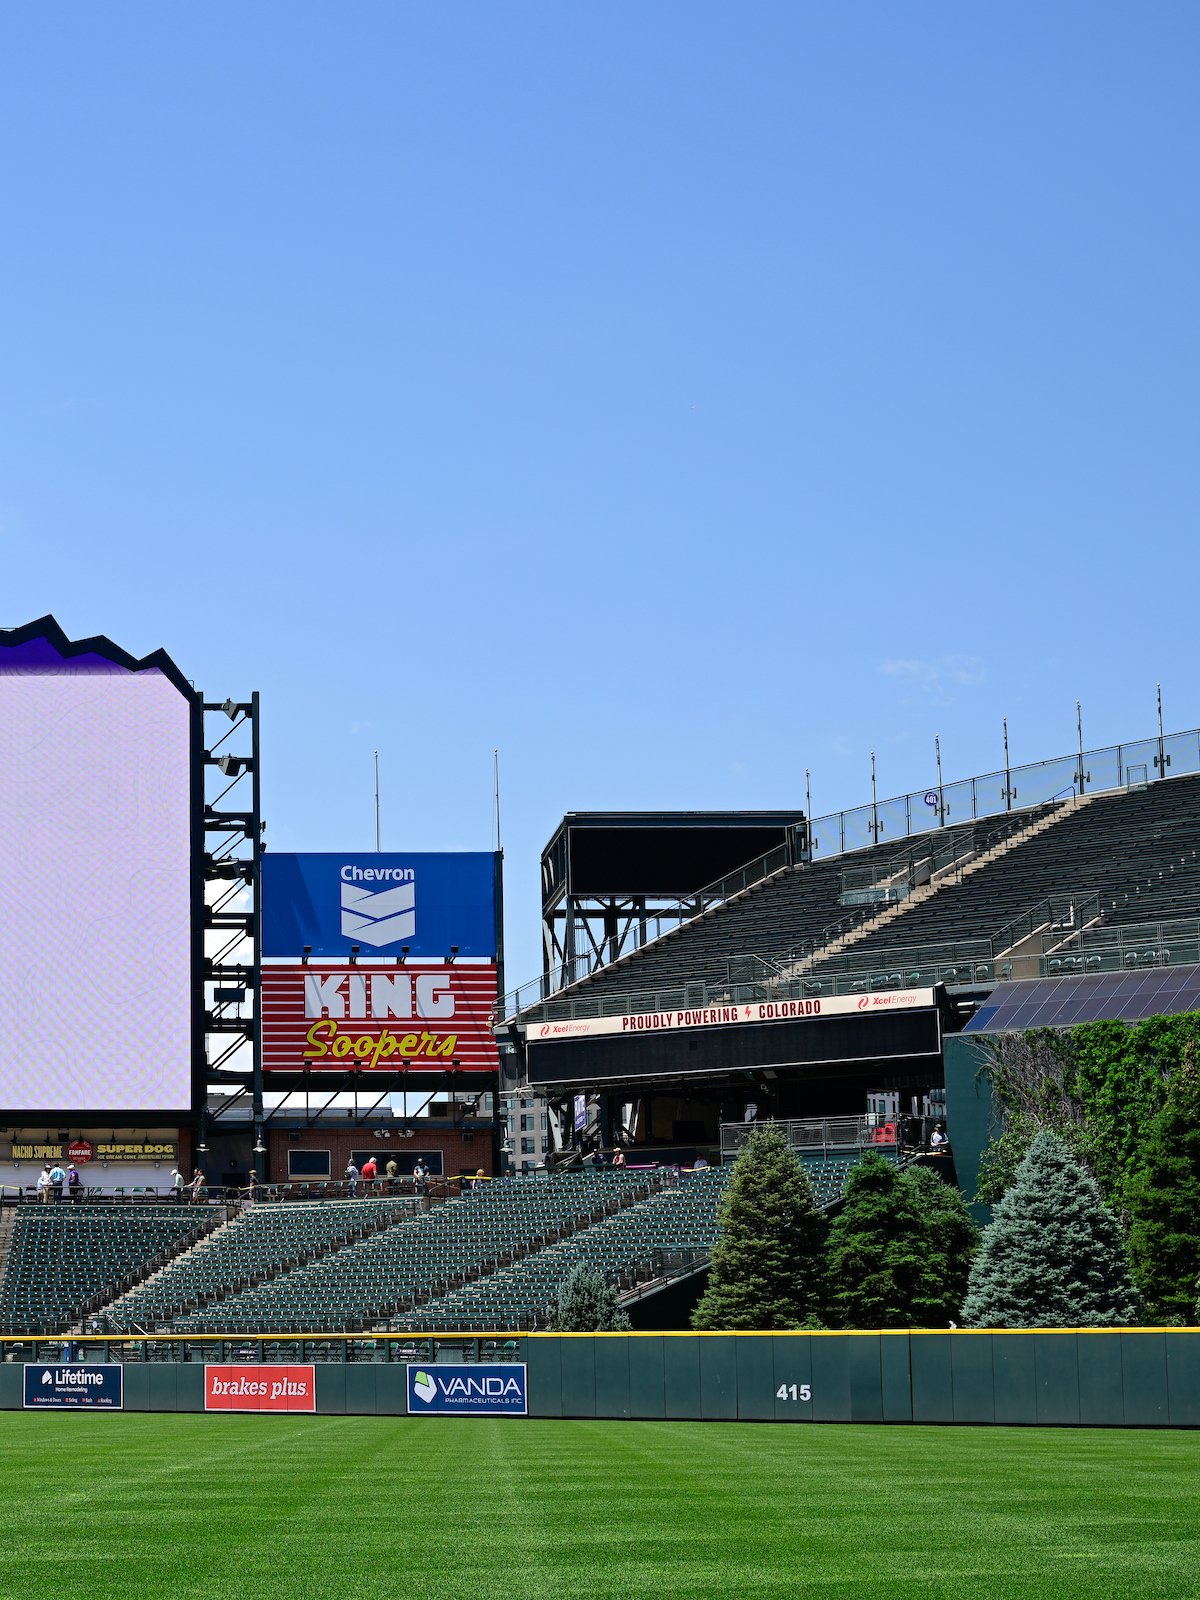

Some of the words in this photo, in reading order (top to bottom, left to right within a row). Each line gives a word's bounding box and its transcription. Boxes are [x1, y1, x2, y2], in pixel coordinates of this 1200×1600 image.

[925, 795, 937, 804] 401
[340, 865, 415, 881] Chevron
[304, 975, 455, 1019] KING
[873, 996, 891, 1005] Xcel
[891, 995, 917, 1005] Energy
[622, 1013, 673, 1031] PROUDLY
[677, 1007, 738, 1026] POWERING
[758, 999, 821, 1019] COLORADO
[552, 1025, 569, 1033] Xcel
[568, 1023, 591, 1034] Energy
[303, 1020, 458, 1068] Soopers
[12, 1145, 33, 1159] NACHO
[34, 1145, 63, 1159] SUPREME
[97, 1144, 143, 1153] SUPER
[144, 1144, 174, 1153] DOG
[55, 1368, 104, 1385] Lifetime
[211, 1376, 268, 1396] brakes
[270, 1377, 307, 1400] plus
[437, 1377, 522, 1396] VANDA
[776, 1384, 812, 1401] 415
